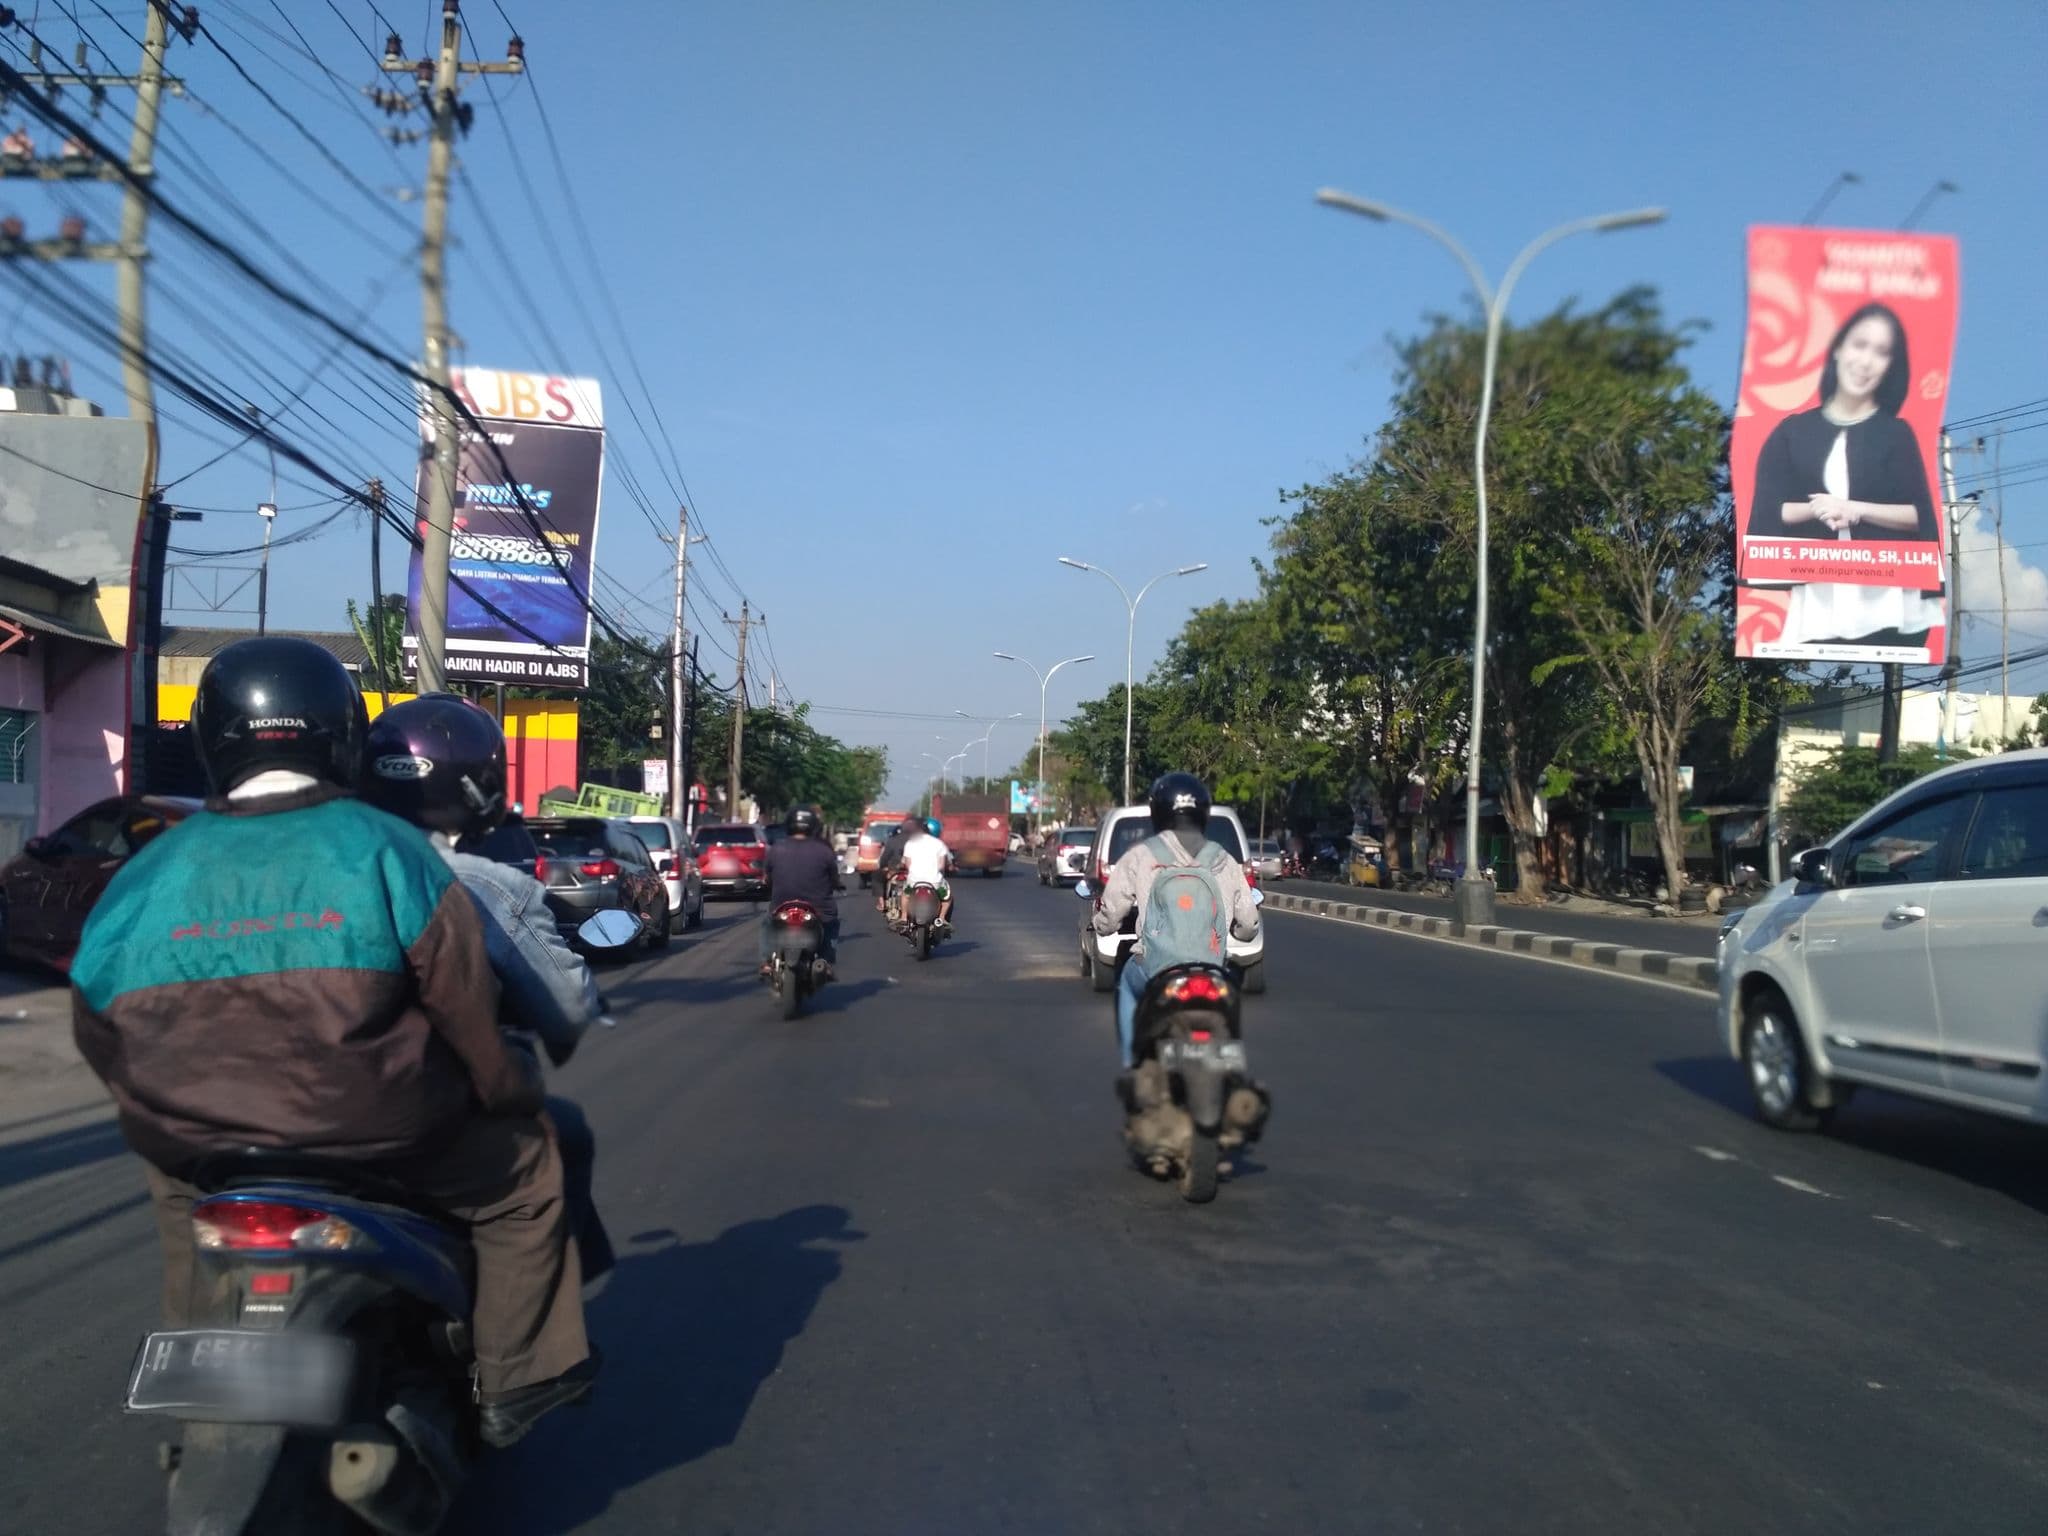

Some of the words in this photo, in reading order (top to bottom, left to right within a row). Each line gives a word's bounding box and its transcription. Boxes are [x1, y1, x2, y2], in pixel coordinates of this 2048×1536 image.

[1750, 546, 1779, 560] DINI
[1782, 547, 1796, 560] S.
[1800, 547, 1875, 564] PURWONO,
[1879, 550, 1902, 565] SH,
[1905, 552, 1937, 566] LLM.
[1789, 566, 1895, 577] www.dinipurwono.id
[486, 659, 525, 674] HADIR
[529, 662, 542, 675] DI
[545, 663, 579, 678] AJBS
[248, 718, 307, 729] HONDA
[171, 908, 345, 941] HONDA
[245, 1304, 286, 1313] HONDA
